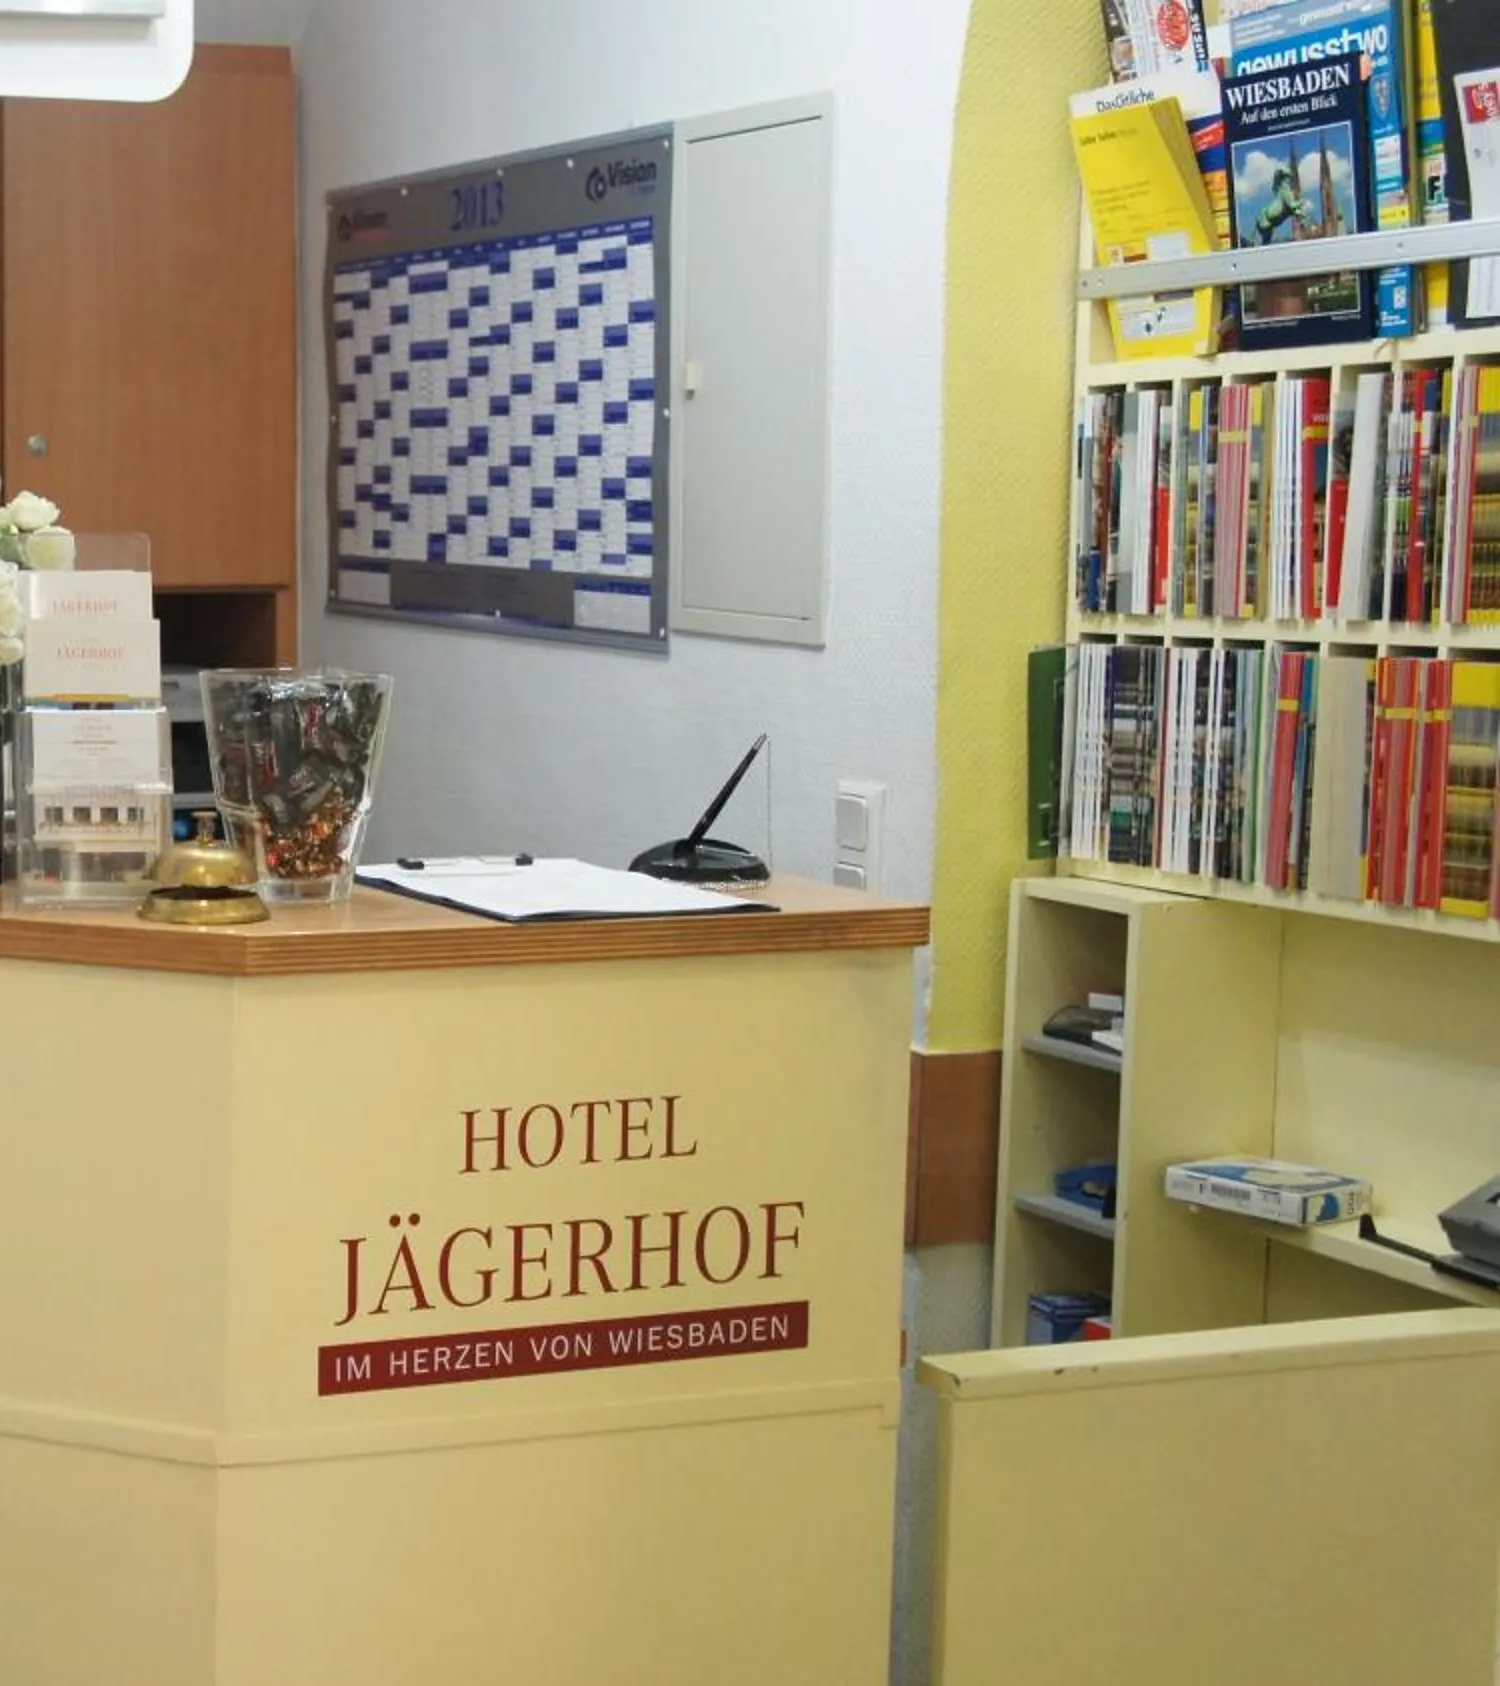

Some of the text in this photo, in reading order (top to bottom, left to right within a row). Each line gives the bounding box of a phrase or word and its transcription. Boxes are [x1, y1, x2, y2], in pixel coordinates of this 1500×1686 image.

[1225, 63, 1350, 111] WIESBADEN
[1241, 108, 1260, 125] Auf
[1260, 107, 1279, 121] den
[1311, 93, 1338, 111] Blick
[607, 158, 657, 187] Vision
[451, 180, 504, 231] 2013
[458, 1095, 698, 1174] HOTEL
[333, 1201, 805, 1326] JÄGERHOF
[334, 1314, 789, 1382] IM HERZEN VON WIESBADEN
